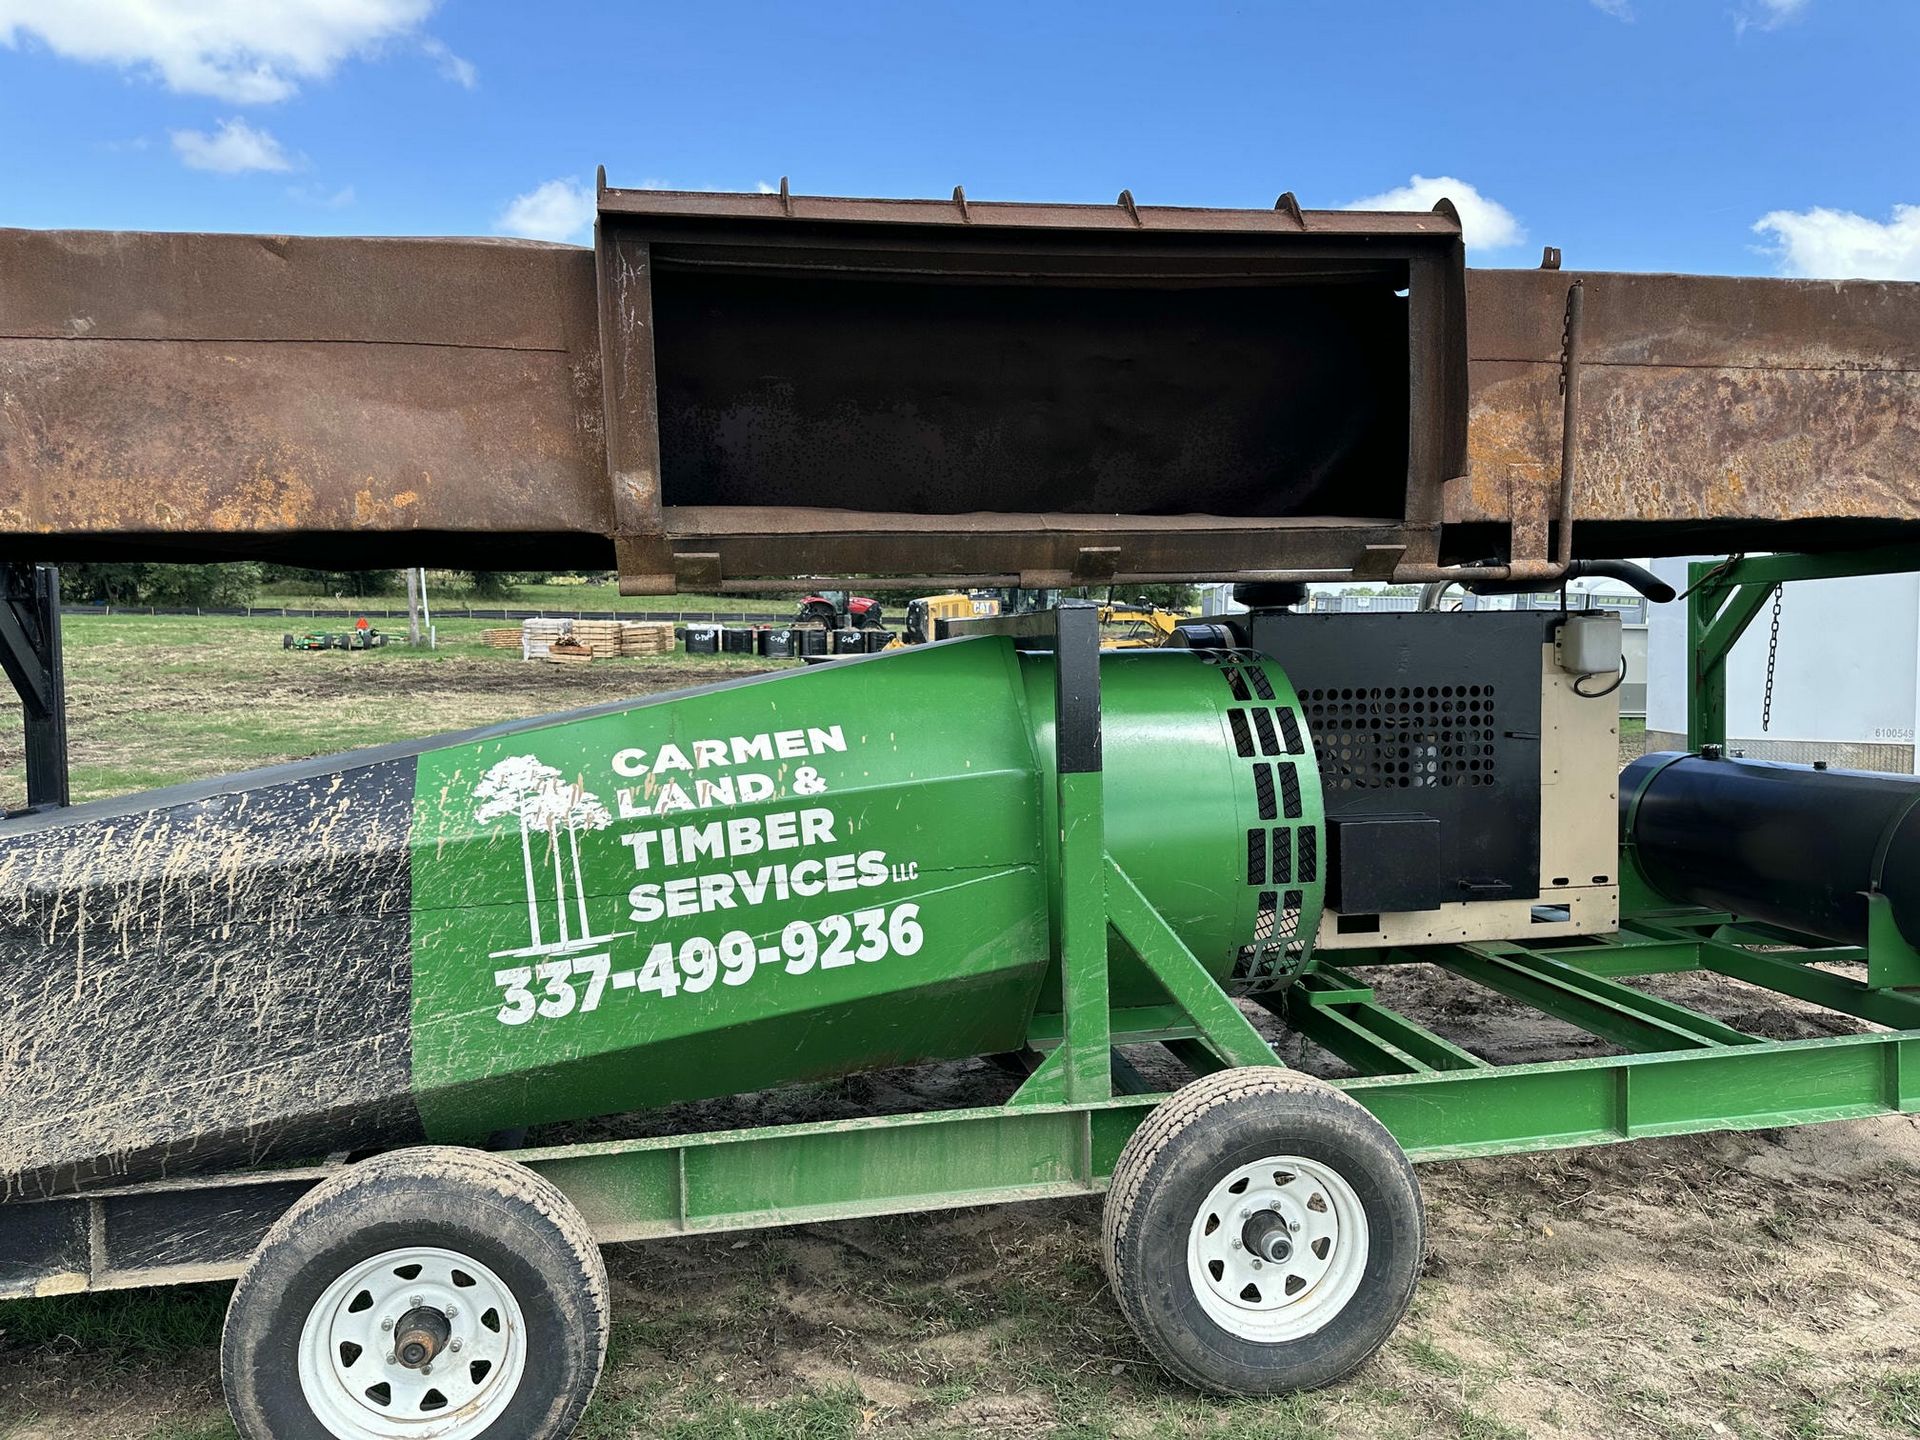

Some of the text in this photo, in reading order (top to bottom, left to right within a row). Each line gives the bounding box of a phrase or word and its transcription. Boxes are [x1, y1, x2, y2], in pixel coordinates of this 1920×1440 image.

[973, 602, 991, 613] CAT
[611, 725, 848, 777] CARMEN
[1875, 728, 1914, 738] 6100549
[617, 766, 828, 818] LAND &
[621, 808, 837, 870] TIMBER
[628, 850, 918, 922] SERVICES LLC
[494, 903, 925, 1026] 337-499-9236
